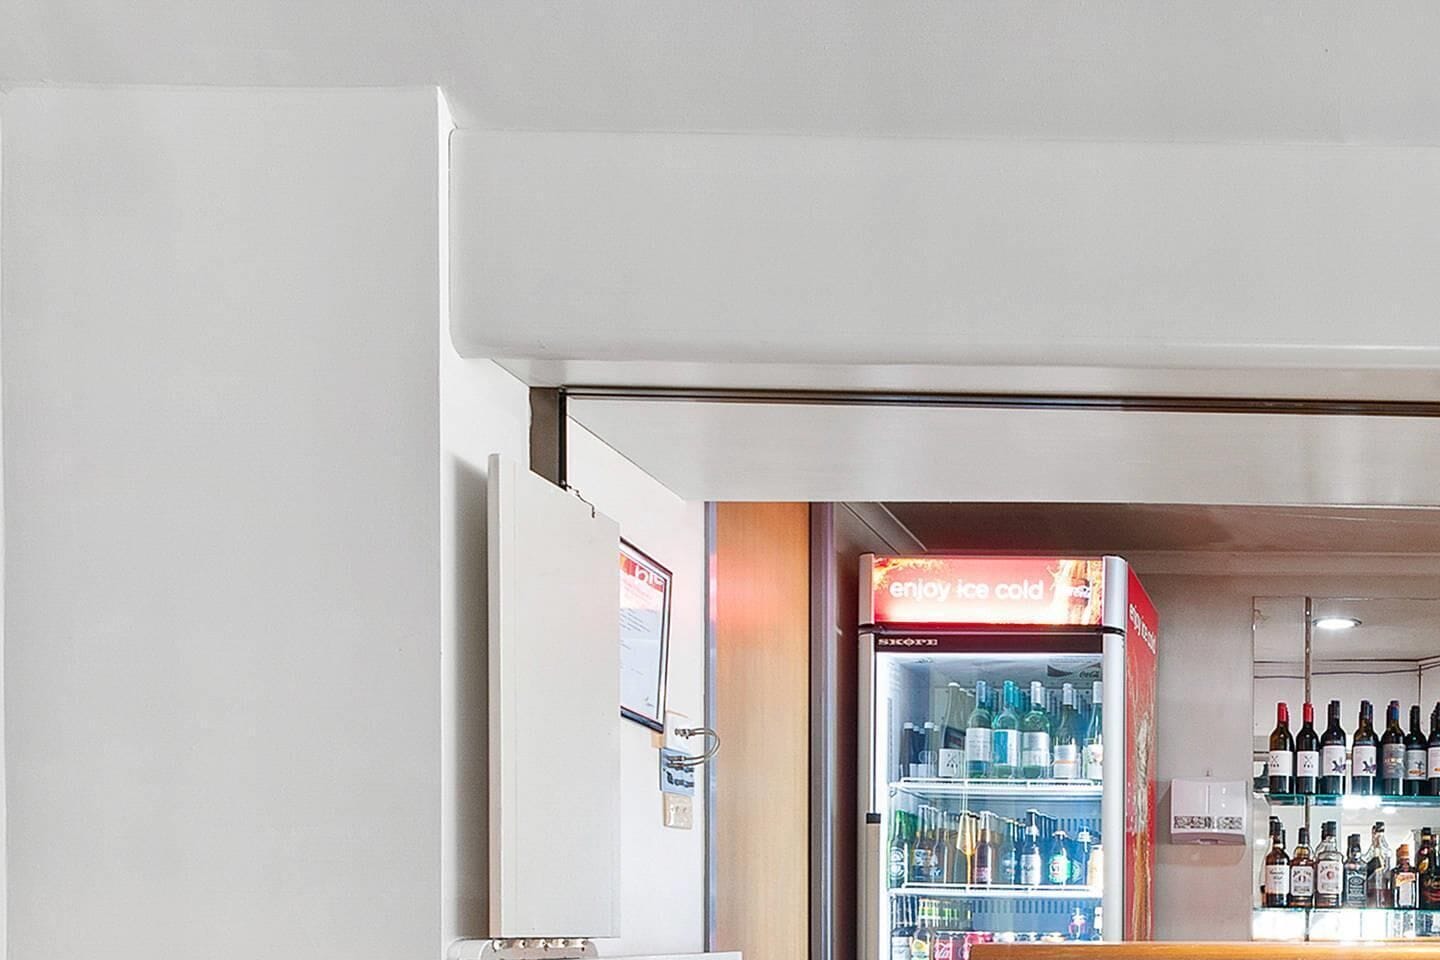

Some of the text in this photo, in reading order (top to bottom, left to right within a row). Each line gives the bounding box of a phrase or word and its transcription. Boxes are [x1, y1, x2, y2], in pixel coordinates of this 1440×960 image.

[889, 579, 1044, 601] enjoy ice cold
[878, 638, 938, 647] SKOPE
